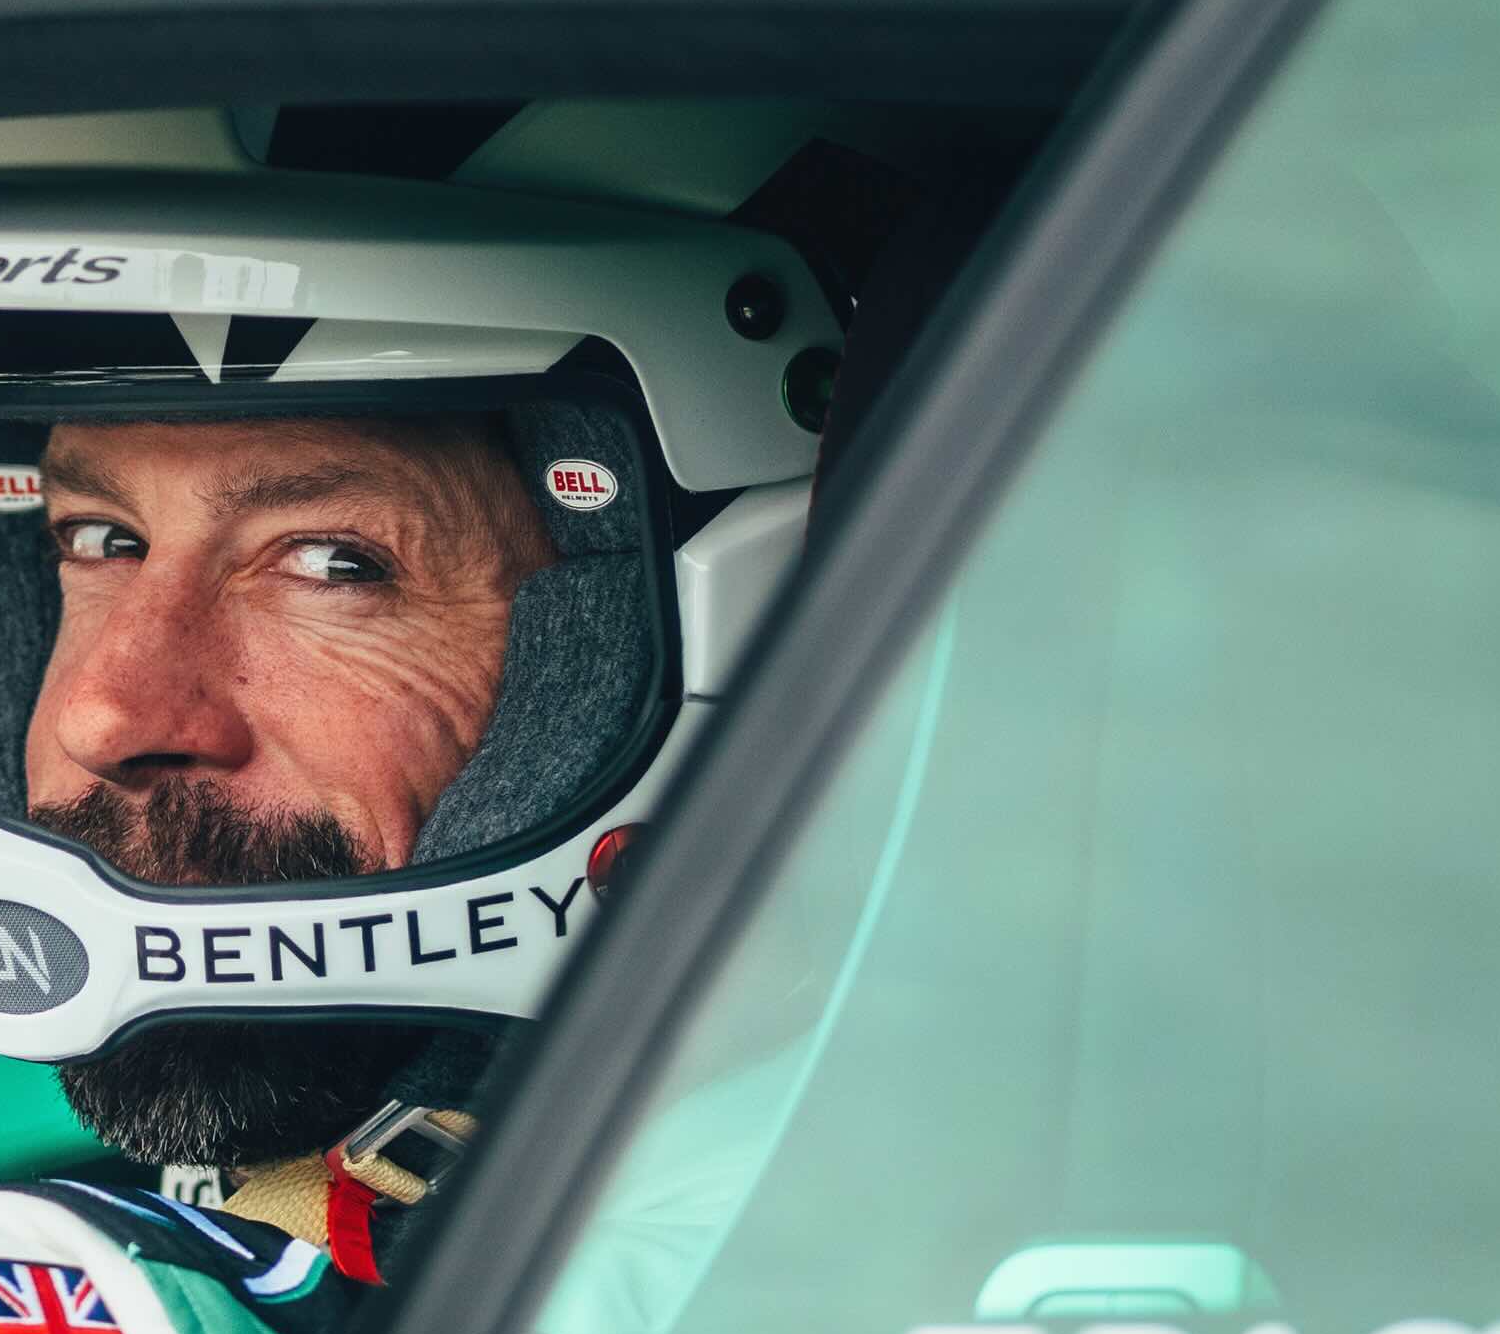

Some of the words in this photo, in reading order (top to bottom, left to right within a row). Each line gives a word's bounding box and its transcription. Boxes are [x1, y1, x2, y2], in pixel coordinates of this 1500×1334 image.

[553, 470, 606, 494] BELL
[561, 494, 599, 503] HELMETS
[137, 877, 586, 984] BENTLEY
